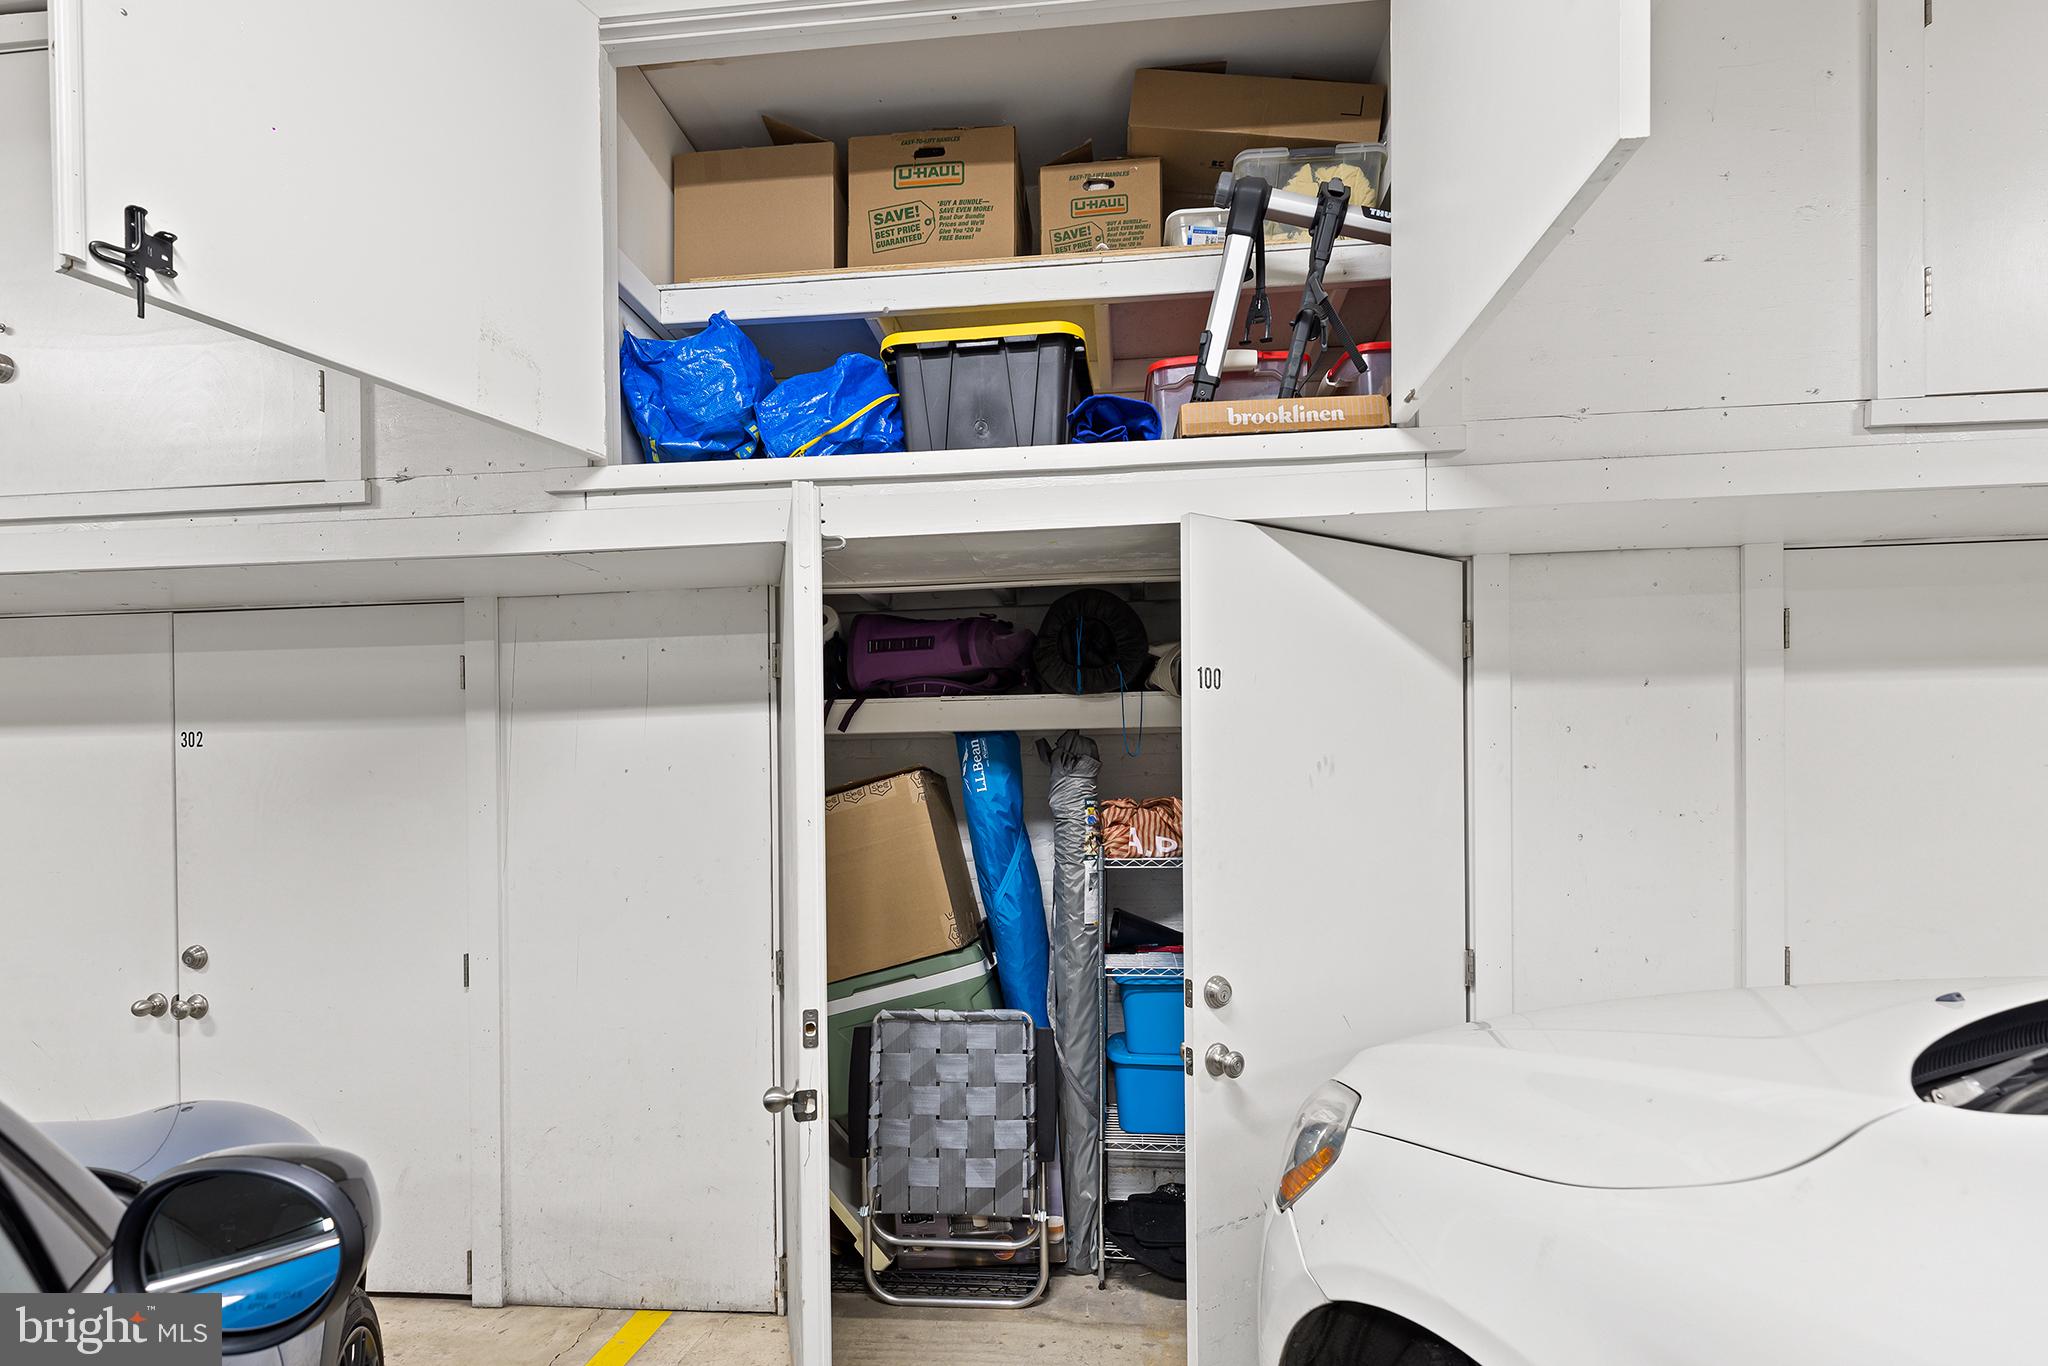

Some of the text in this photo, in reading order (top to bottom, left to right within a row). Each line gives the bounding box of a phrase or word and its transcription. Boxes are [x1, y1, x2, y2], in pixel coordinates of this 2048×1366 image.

[898, 165, 960, 180] U-HAUL
[939, 206, 955, 214] SAVE
[1074, 198, 1125, 211] U-HAUL
[873, 205, 920, 226] SAVE!
[874, 223, 921, 240] BEST PRICE
[1053, 225, 1092, 243] SAVE!
[1055, 244, 1071, 254] BEST
[1072, 239, 1093, 251] PRICE
[1226, 404, 1345, 426] brooklinen
[1197, 666, 1221, 690] 100
[180, 731, 204, 748] 302
